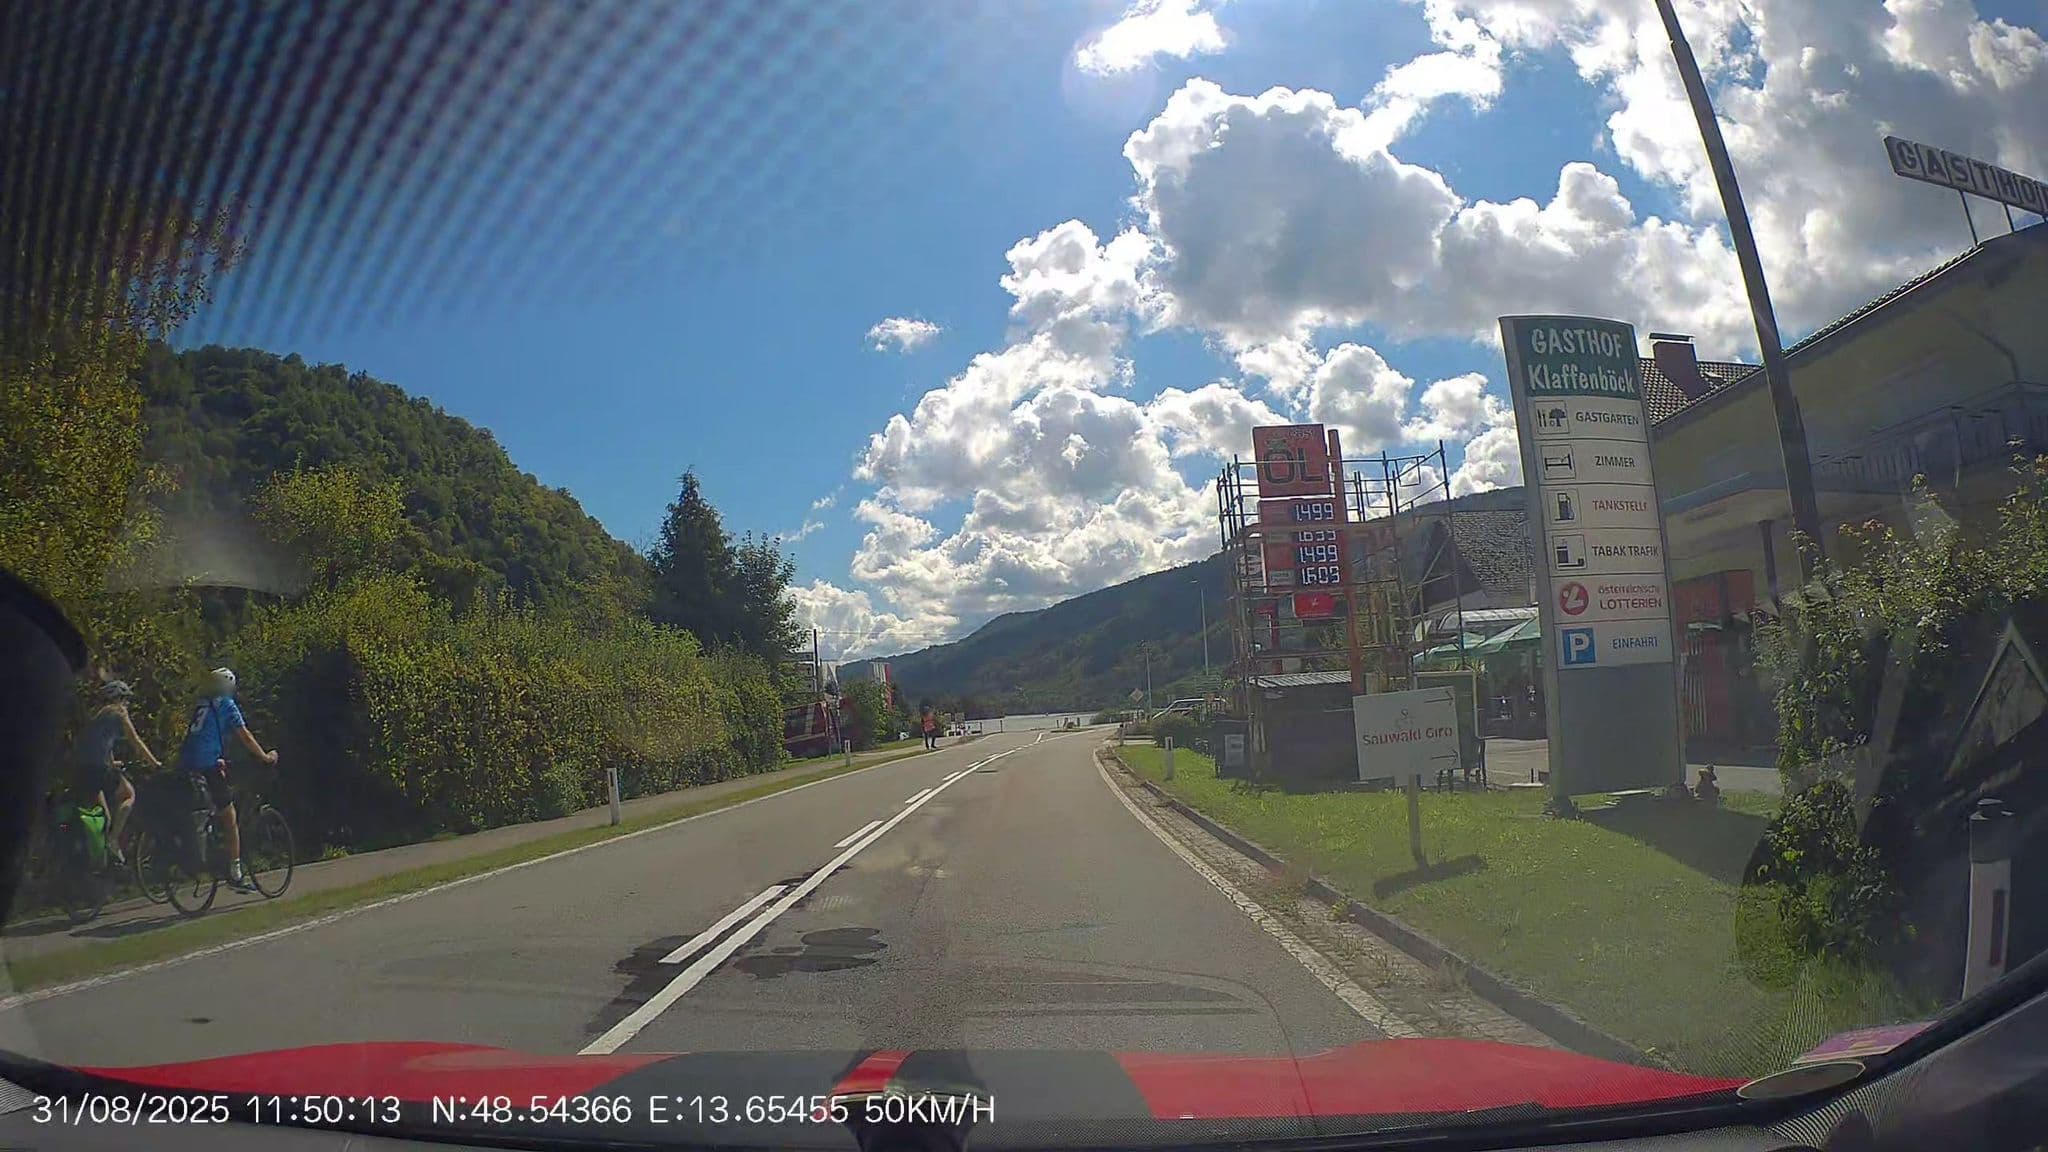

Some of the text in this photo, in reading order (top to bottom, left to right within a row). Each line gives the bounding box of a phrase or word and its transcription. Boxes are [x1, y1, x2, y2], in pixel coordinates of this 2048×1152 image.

[1531, 327, 1623, 358] GASTHOF
[1527, 363, 1636, 394] Klaffenböck
[1575, 411, 1640, 426] GASTGARTEN
[1594, 454, 1636, 469] ZIMMER
[1296, 502, 1334, 521] 1.499
[1592, 499, 1649, 513] TANKSTELLE
[1299, 544, 1339, 563] 1.499
[1591, 544, 1660, 558] TABAK TRAFIK
[1599, 597, 1663, 610] LOTTERIEN
[1569, 632, 1659, 662] P EINFAHRT
[1425, 727, 1453, 739] Giro
